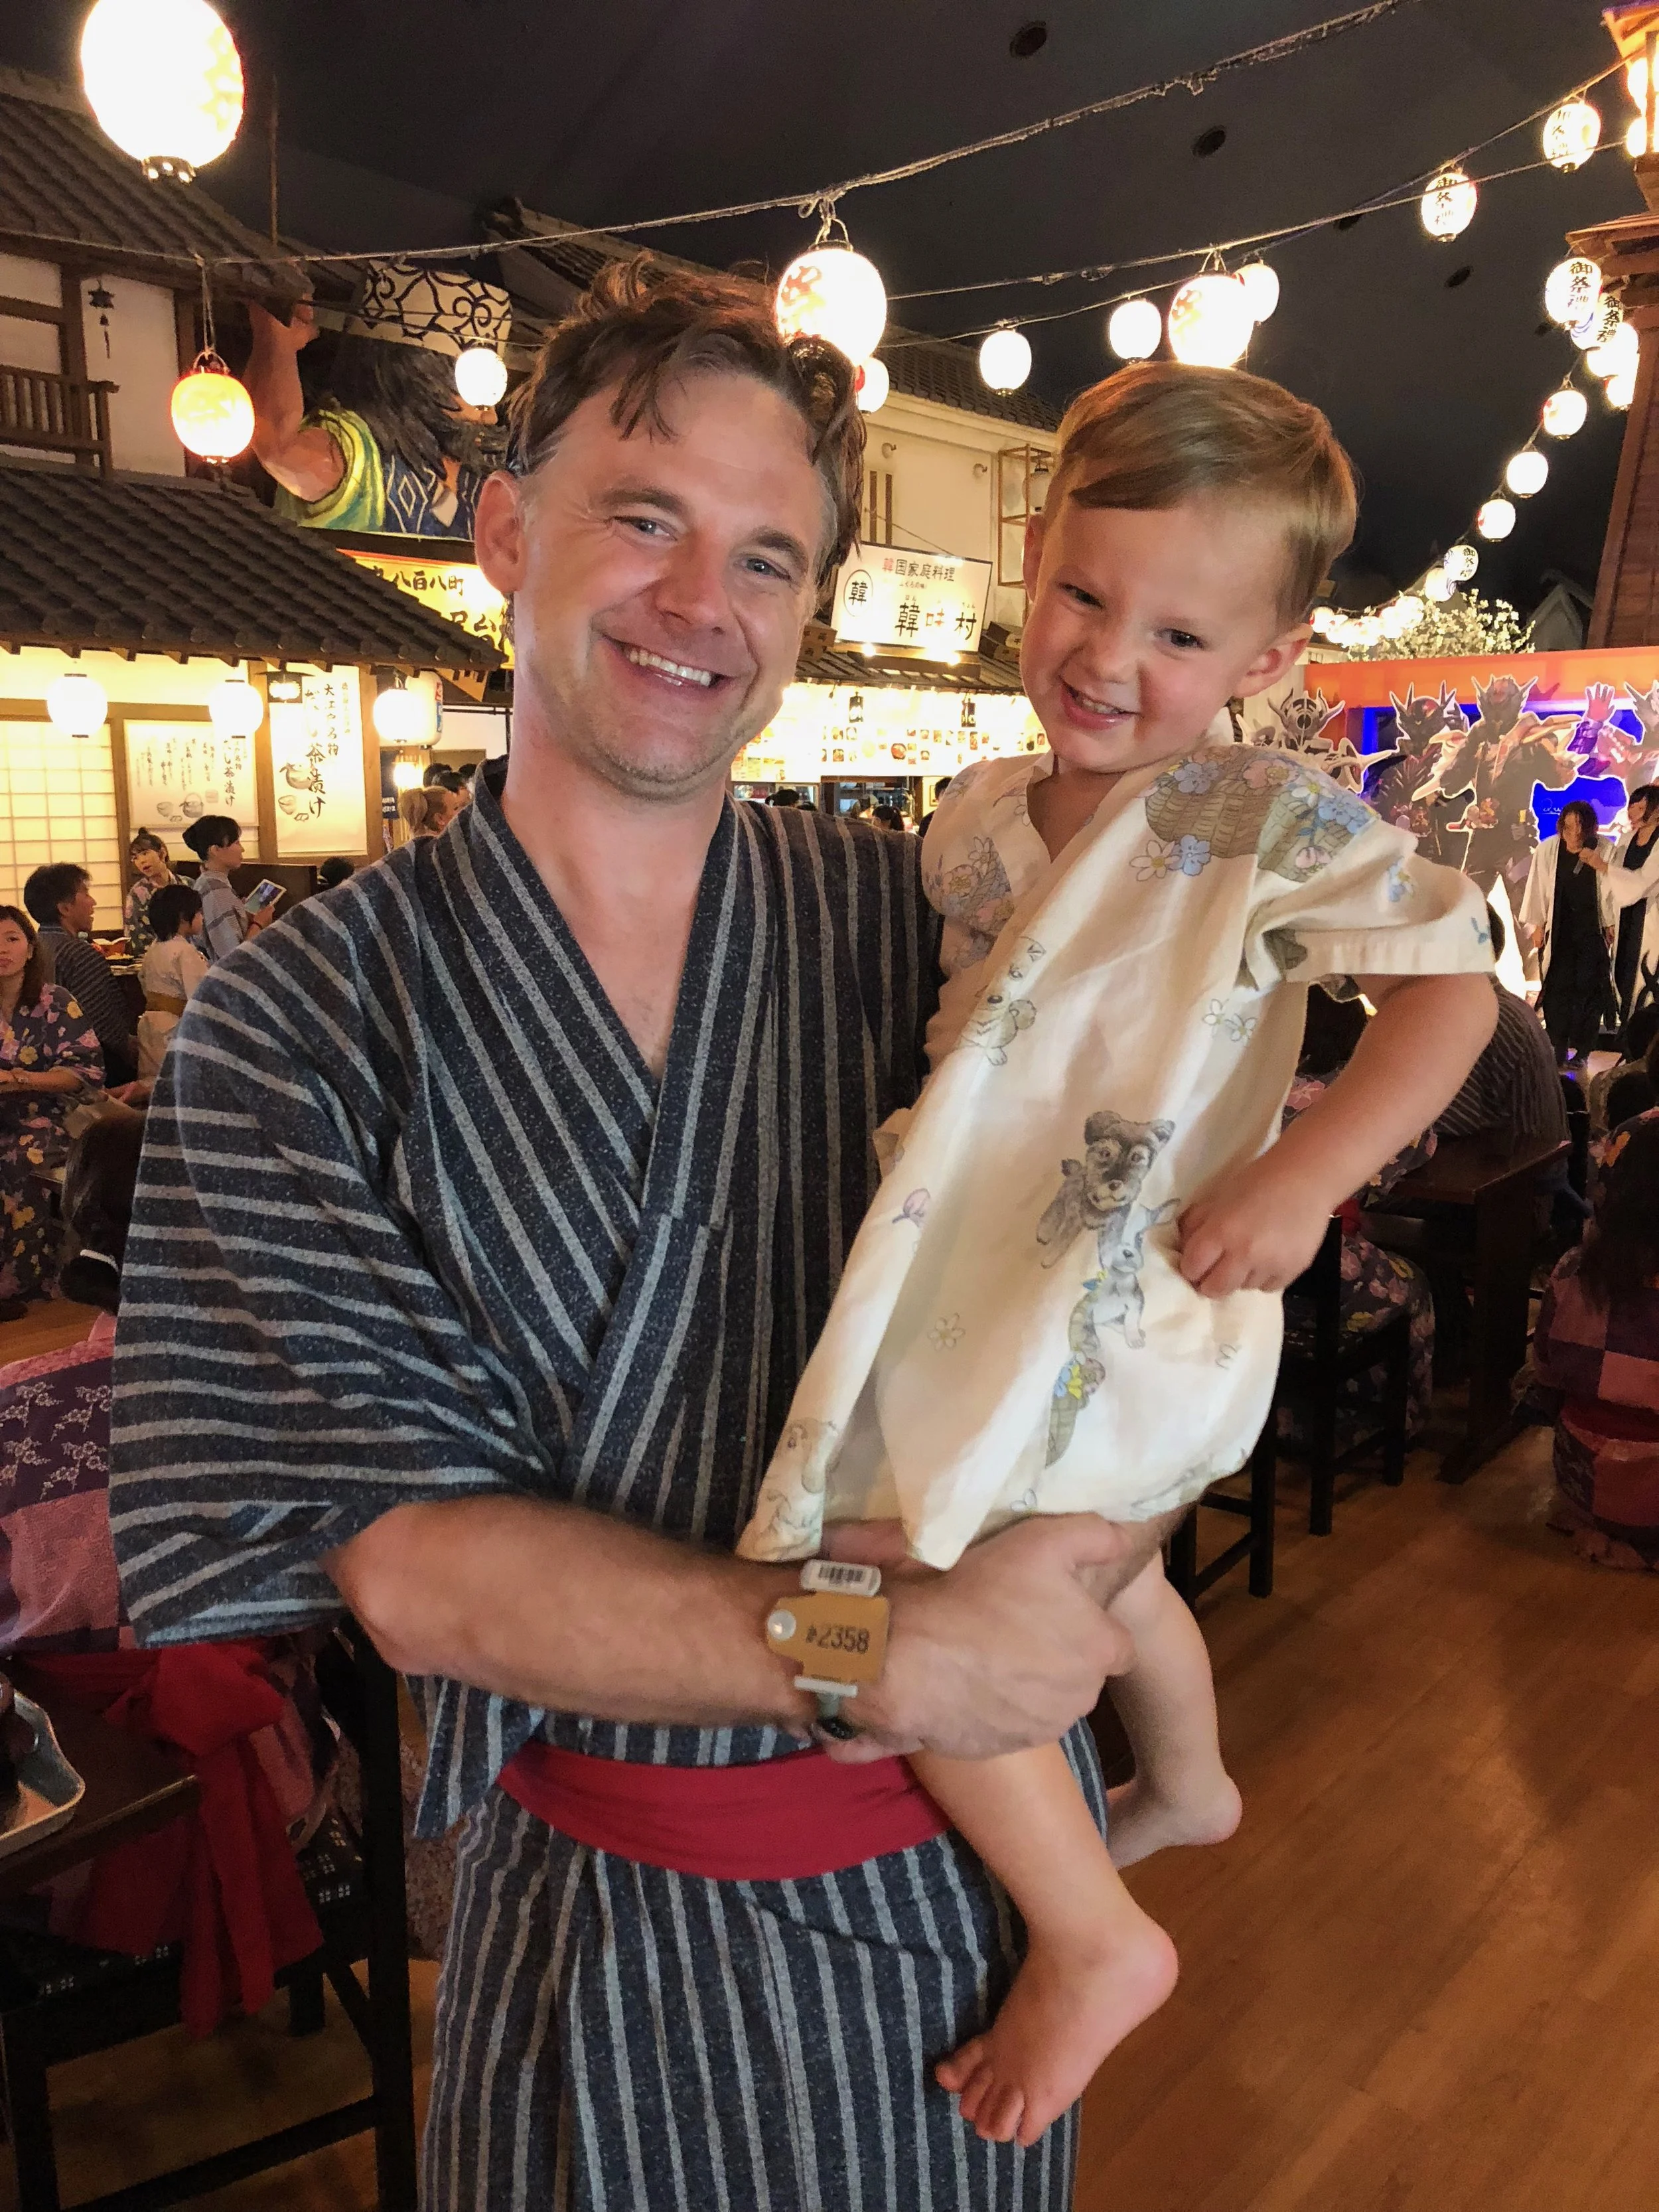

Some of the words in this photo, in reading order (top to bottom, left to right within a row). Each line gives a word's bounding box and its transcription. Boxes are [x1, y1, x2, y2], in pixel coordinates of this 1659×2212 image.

[883, 557, 955, 581] 韓国家庭料理
[848, 580, 869, 606] 韓
